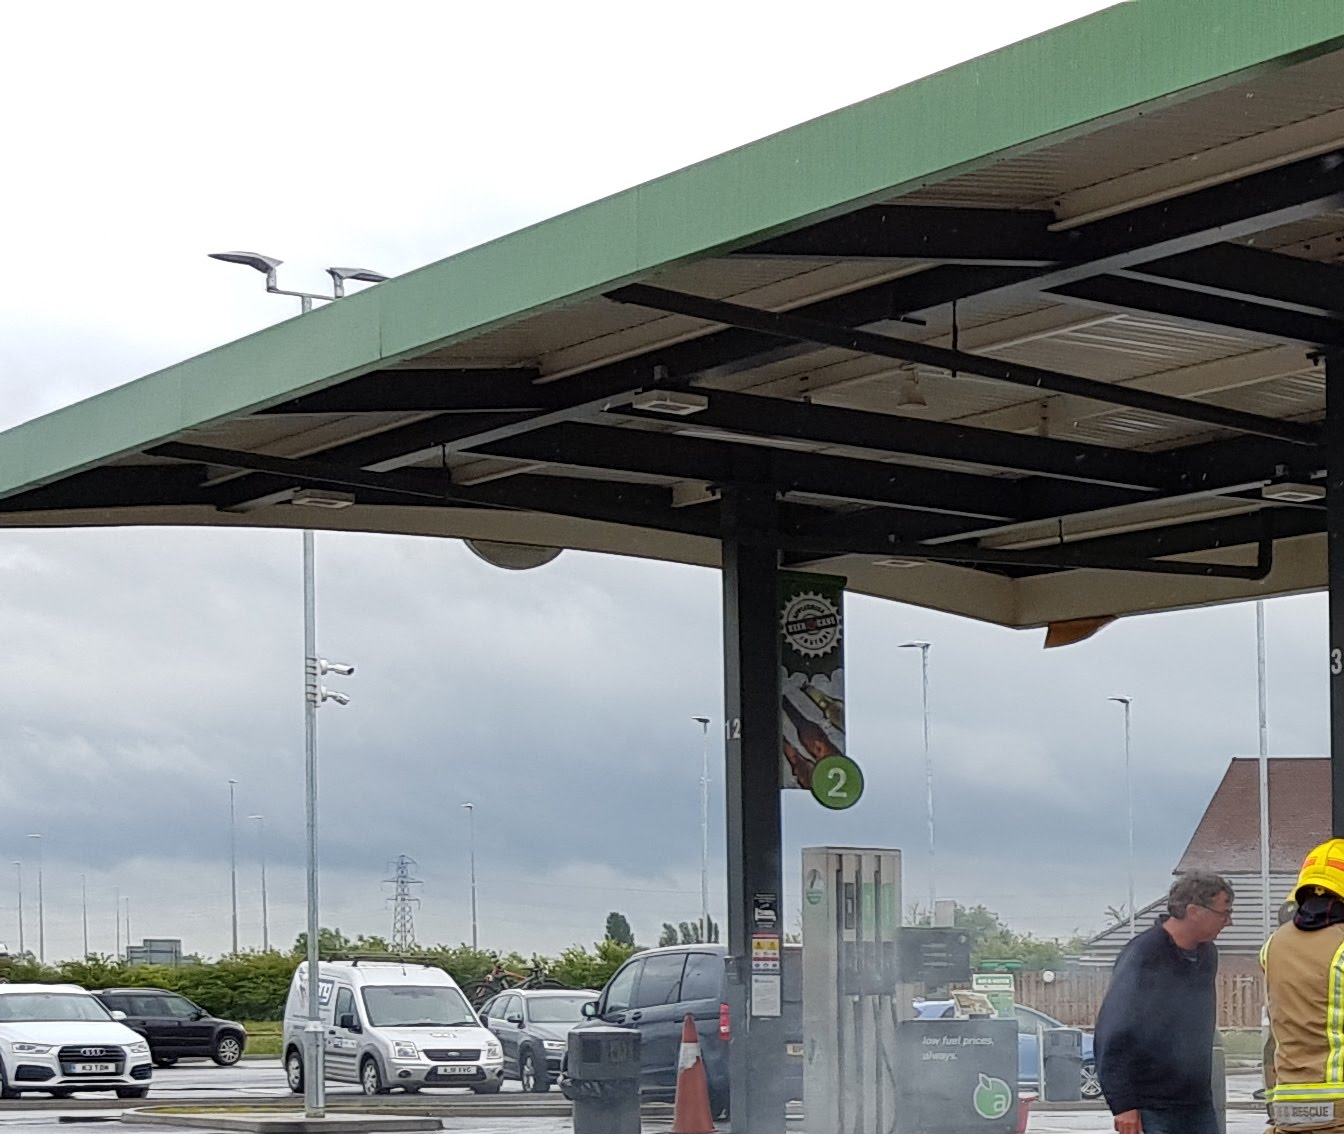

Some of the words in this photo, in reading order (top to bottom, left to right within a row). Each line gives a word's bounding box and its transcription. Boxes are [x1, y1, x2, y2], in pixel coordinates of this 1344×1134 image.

[724, 718, 742, 740] 12
[827, 767, 848, 798] 2
[922, 1036, 940, 1046] low
[942, 1035, 961, 1045] fuel
[1291, 1106, 1329, 1118] RESCUE
